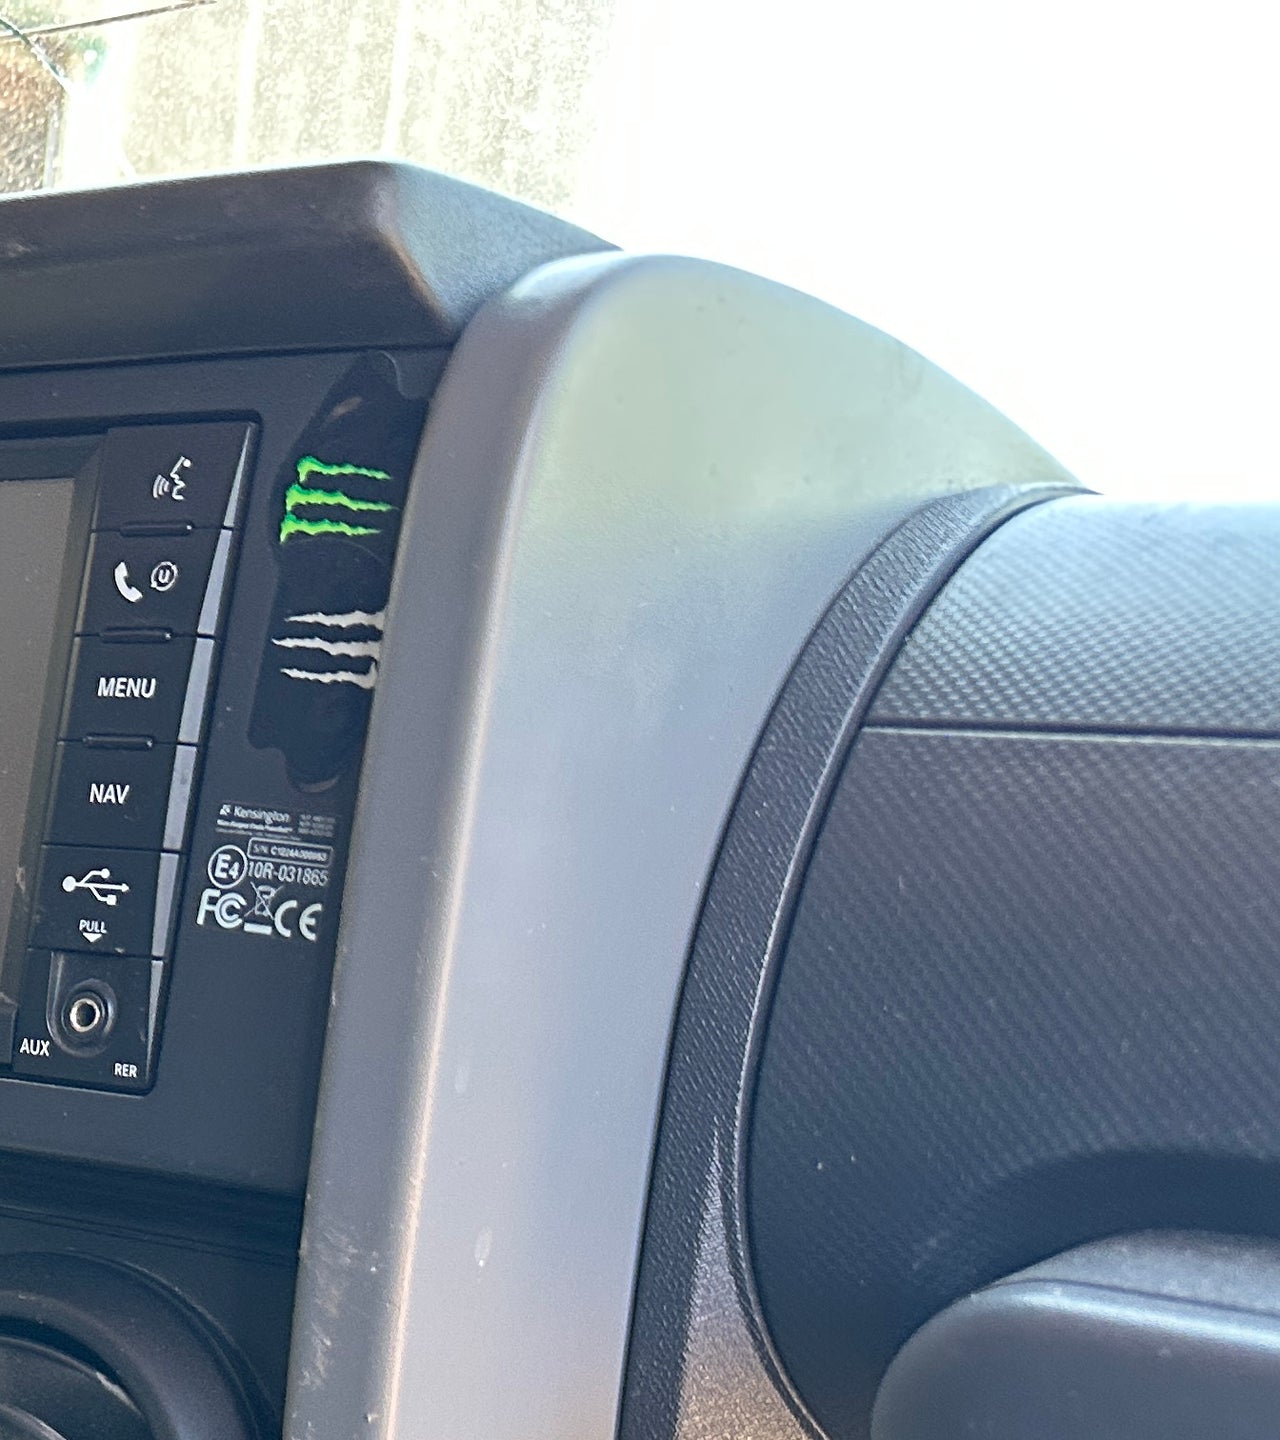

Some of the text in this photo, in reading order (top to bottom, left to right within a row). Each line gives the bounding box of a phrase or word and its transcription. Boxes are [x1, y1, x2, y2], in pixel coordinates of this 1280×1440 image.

[97, 676, 157, 699] MENU
[89, 783, 130, 805] NAV
[79, 918, 108, 934] PULL
[19, 1037, 51, 1057] AUX
[114, 1062, 138, 1079] RER
